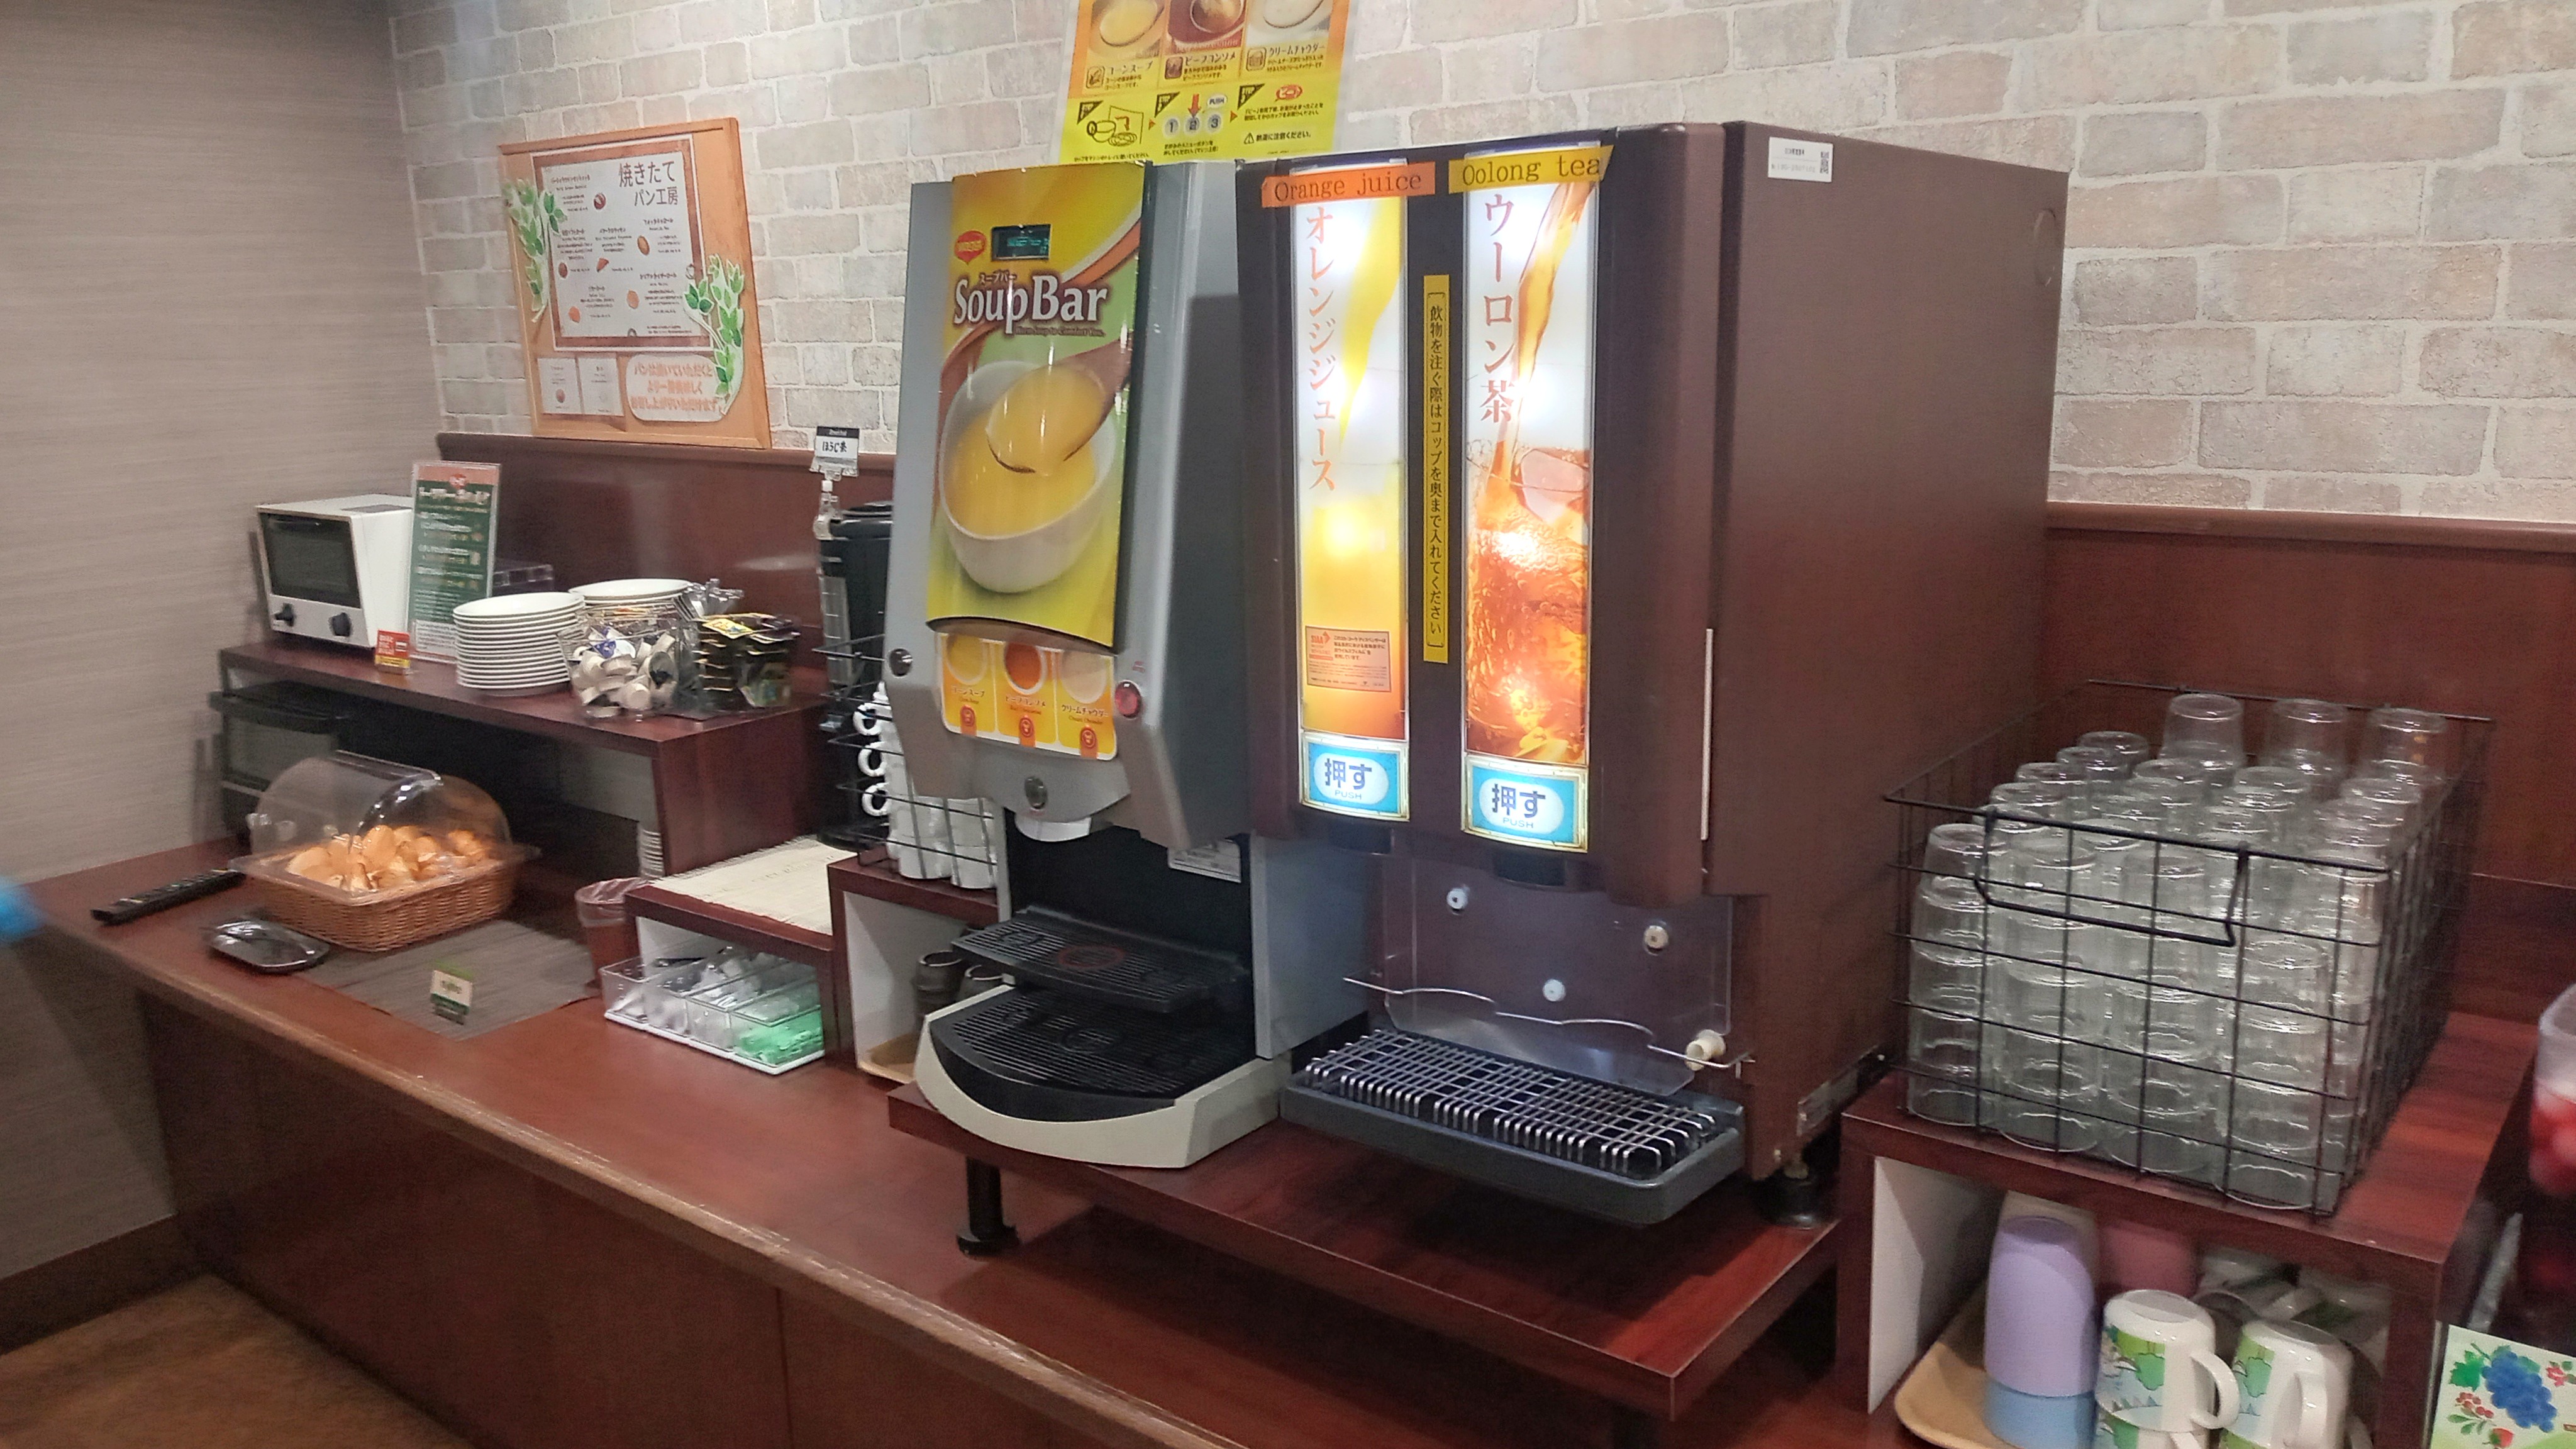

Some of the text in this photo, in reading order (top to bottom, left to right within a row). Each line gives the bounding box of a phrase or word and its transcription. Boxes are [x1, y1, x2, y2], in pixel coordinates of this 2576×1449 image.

[1211, 118, 1219, 129] 3
[618, 160, 675, 187] 焼きたて
[1462, 155, 1601, 186] Oolong tea
[634, 186, 678, 206] パン工房
[1274, 170, 1422, 203] Orange juice
[979, 269, 1018, 285] スープバー
[1480, 193, 1515, 423] ウーロン茶
[1306, 206, 1336, 491] オレンジジュース
[1324, 757, 1372, 791] 押す
[1334, 790, 1362, 801] PUSH
[1491, 783, 1546, 818] 押す
[1502, 817, 1534, 829] PUSH
